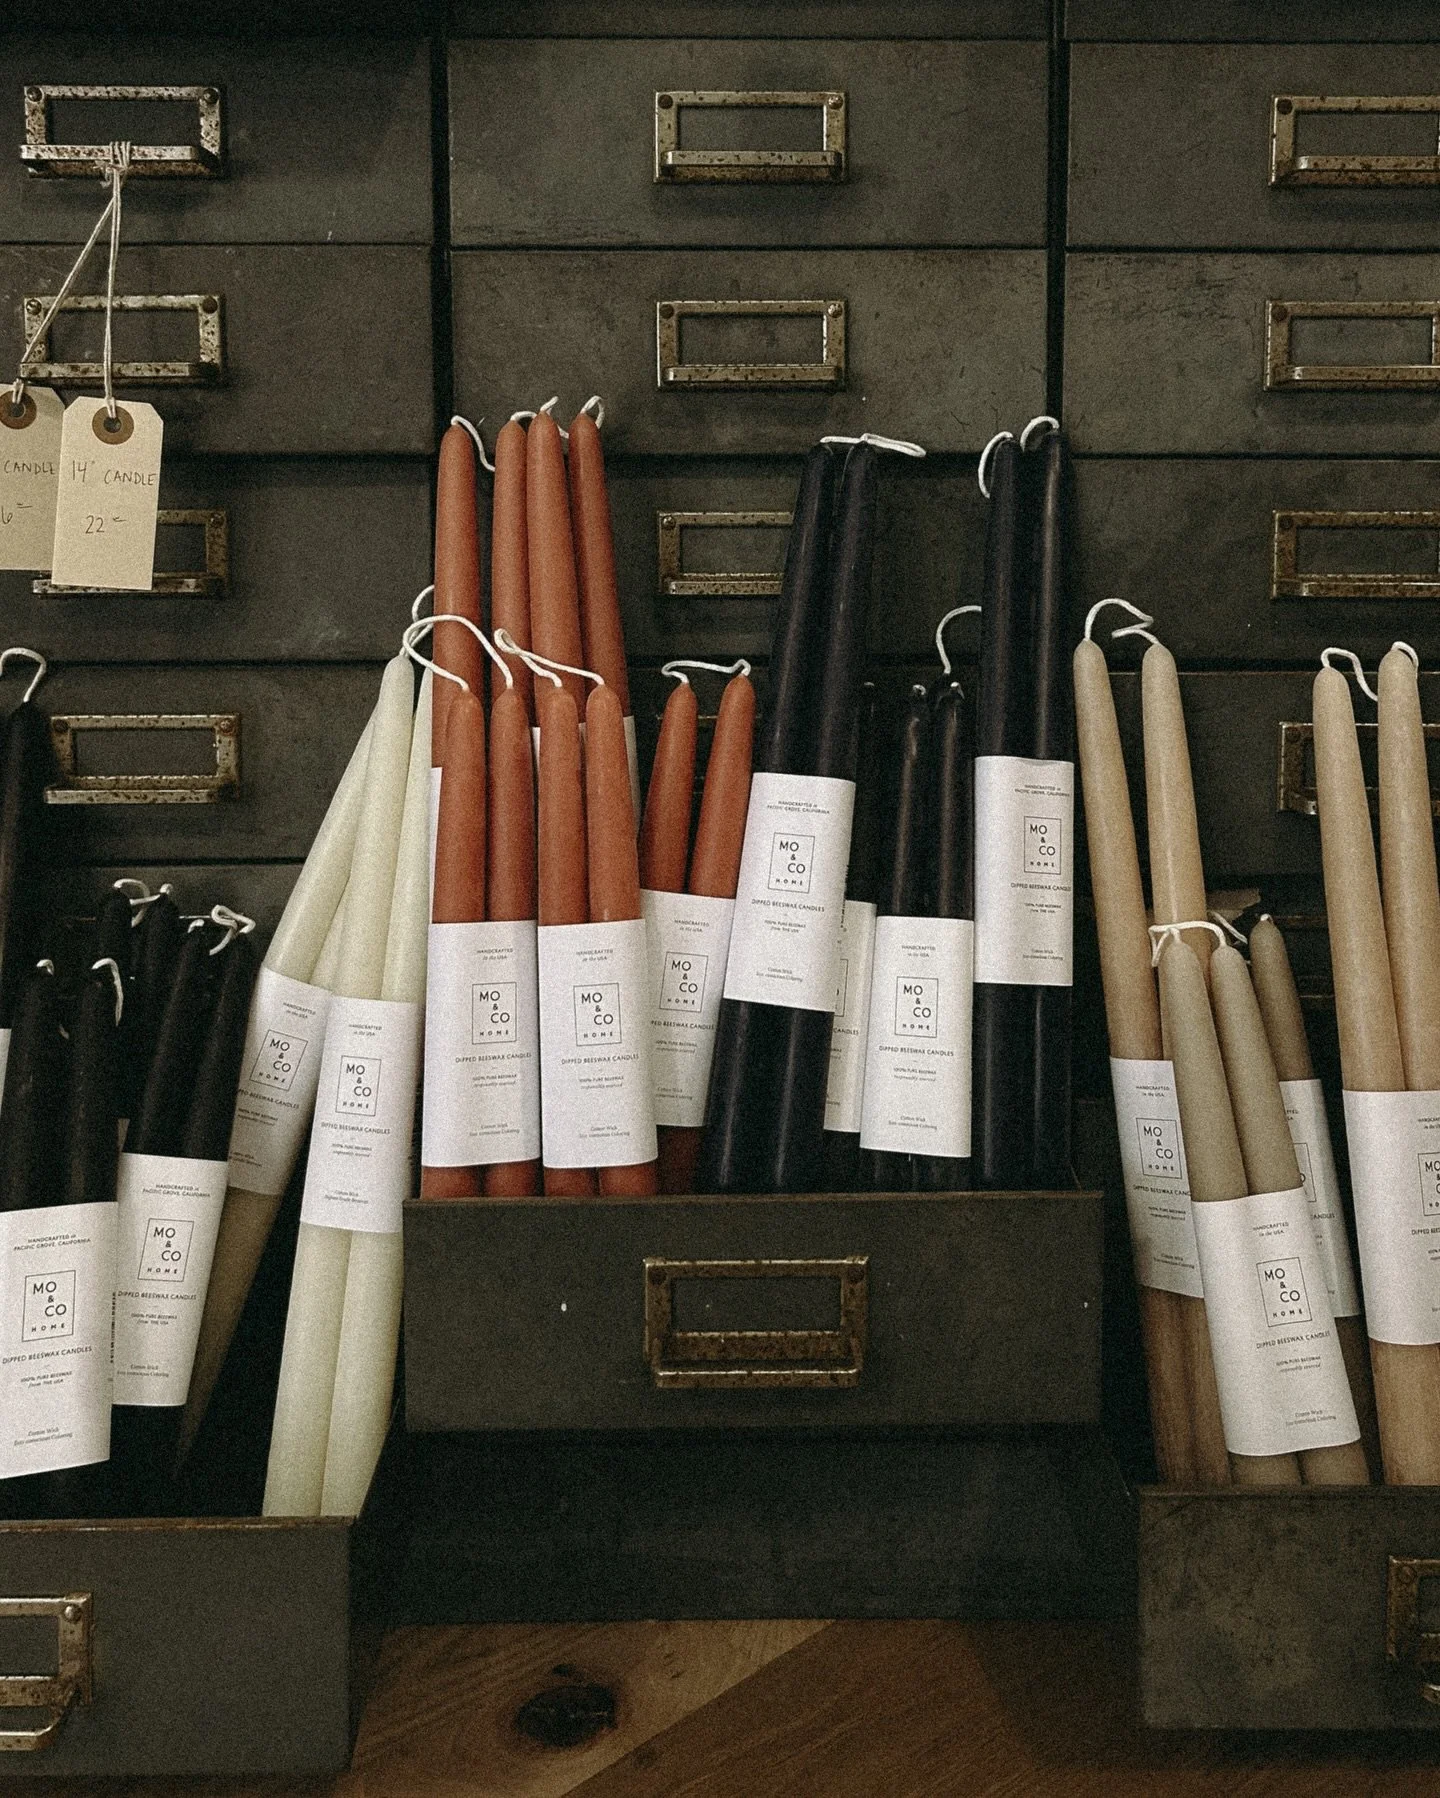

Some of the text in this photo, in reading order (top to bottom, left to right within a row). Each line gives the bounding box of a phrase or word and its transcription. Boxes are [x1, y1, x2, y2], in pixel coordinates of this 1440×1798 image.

[104, 469, 156, 486] CANDLE
[1030, 824, 1047, 835] MO
[779, 840, 799, 852] MO
[1040, 836, 1046, 844] &
[1039, 845, 1056, 856] CO
[787, 862, 806, 874] CO
[772, 901, 797, 909] BEESWAX
[798, 904, 825, 912] CANDLES
[671, 960, 691, 971] MO
[679, 982, 698, 993] CO
[903, 984, 923, 996] MO
[480, 990, 500, 1002] MO
[581, 992, 603, 1004] MO
[915, 997, 921, 1005] &
[493, 1003, 498, 1011] &
[595, 1005, 601, 1013] &
[913, 1006, 931, 1018] CO
[490, 1012, 510, 1024] CO
[593, 1013, 614, 1025] CO
[269, 1038, 290, 1052] MO
[879, 1045, 899, 1053] DIPPED
[927, 1049, 954, 1057] CANDLES
[612, 1054, 639, 1062] CANDLES
[273, 1060, 291, 1073] CO
[346, 1063, 365, 1075] MO
[353, 1086, 372, 1097] CO
[339, 1124, 363, 1132] BEESWAX
[364, 1126, 391, 1135] CANDLES
[1143, 1125, 1162, 1137] MO
[1155, 1148, 1174, 1159] CO
[153, 1227, 176, 1239] MO
[165, 1240, 172, 1248] &
[161, 1250, 182, 1262] CO
[1264, 1268, 1285, 1281] MO
[32, 1281, 57, 1295] MO
[1280, 1281, 1286, 1289] &
[47, 1295, 54, 1303] &
[141, 1292, 169, 1300] BEESWAX
[1280, 1290, 1300, 1303] CO
[44, 1303, 67, 1317] CO
[31, 1322, 65, 1332] HOME
[1256, 1340, 1276, 1349] DIPPED
[1277, 1336, 1304, 1345] BEESWAX
[2, 1346, 92, 1364] DIPPED BEESWAX CANDLES
